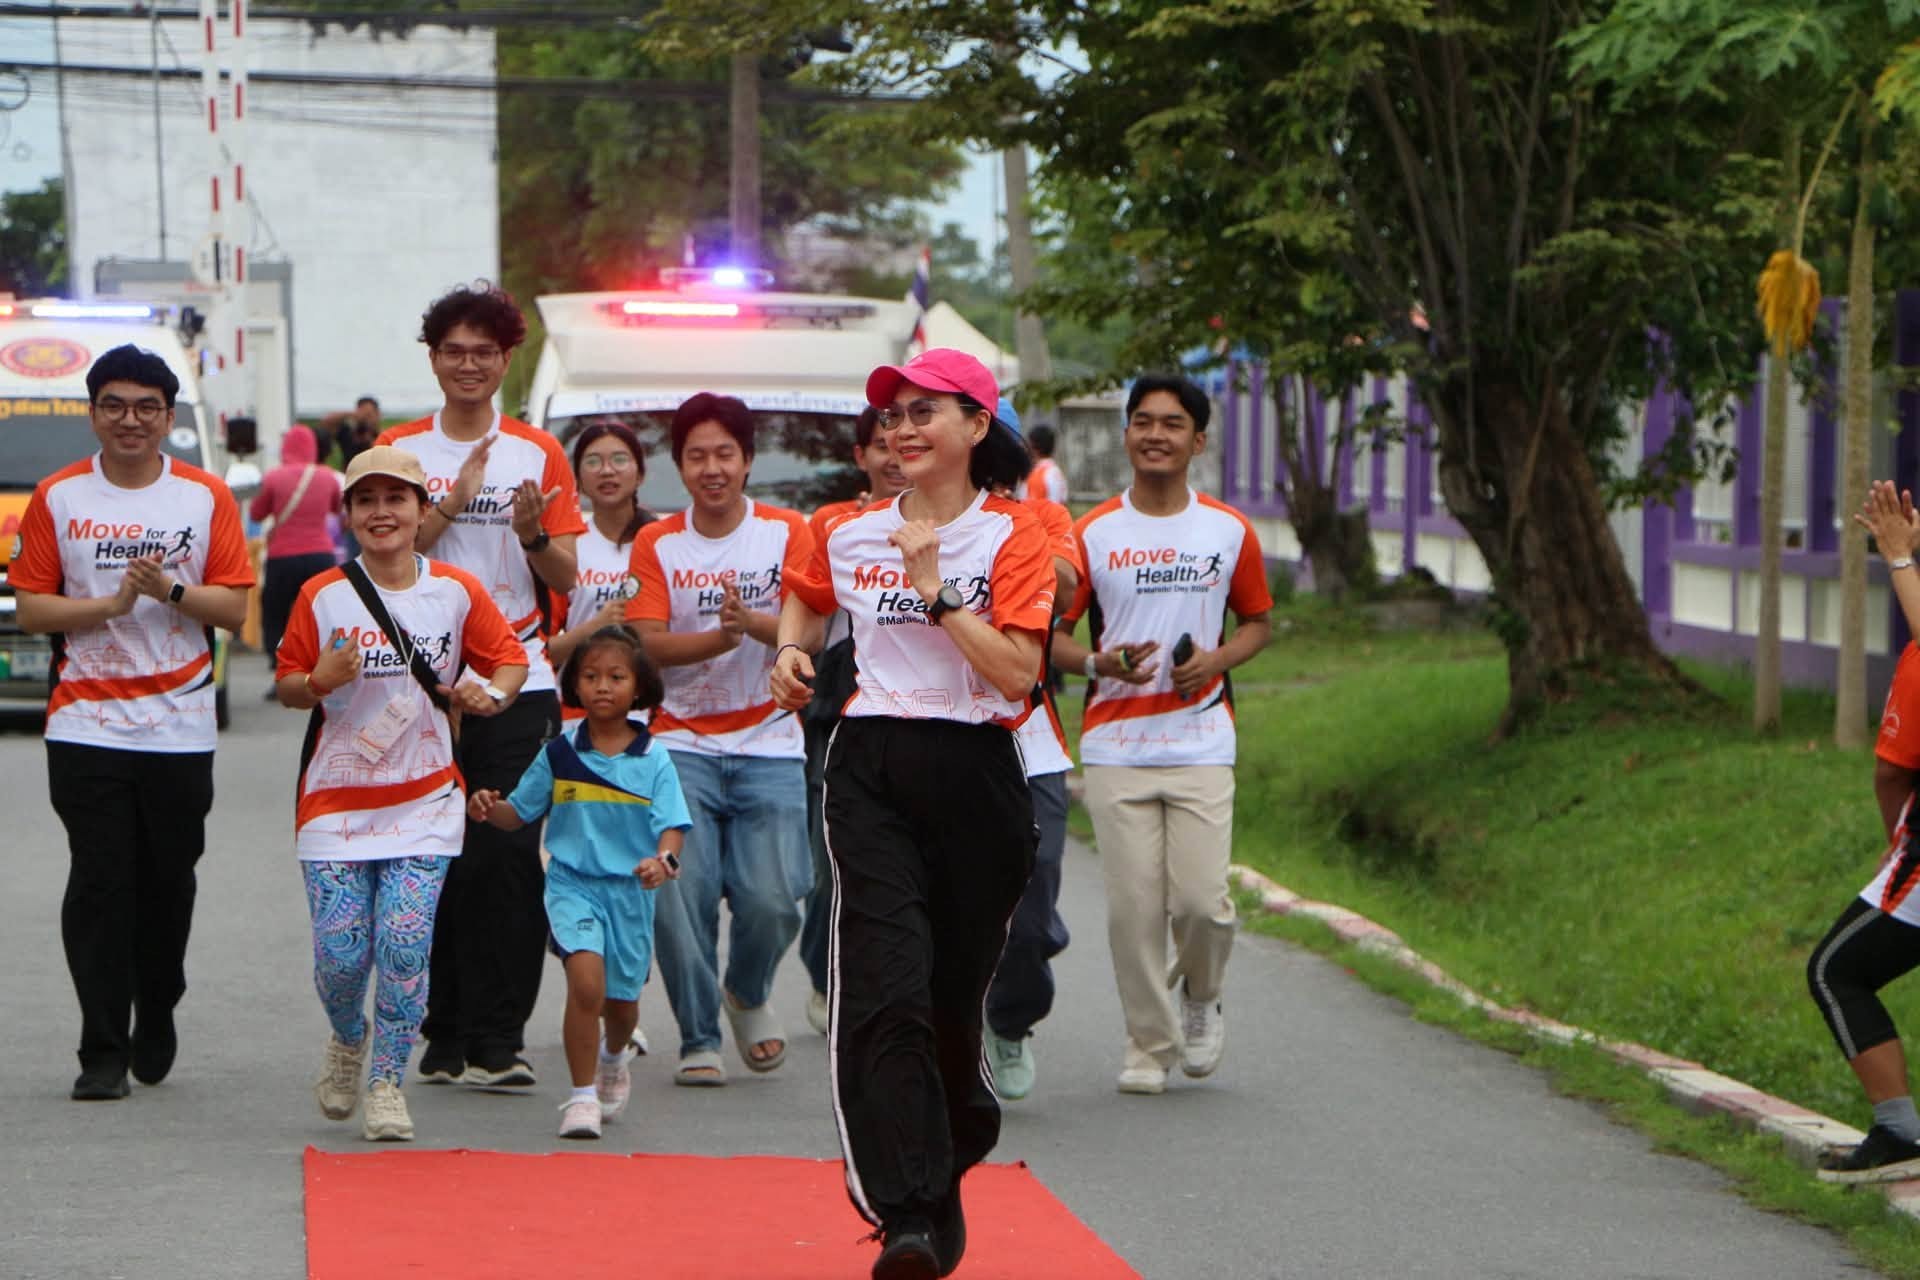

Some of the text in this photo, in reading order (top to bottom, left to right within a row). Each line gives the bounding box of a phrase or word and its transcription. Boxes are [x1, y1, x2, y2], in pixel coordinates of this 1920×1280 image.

[67, 519, 167, 540] Move for
[95, 541, 167, 559] Health
[1108, 547, 1199, 571] Move for
[672, 569, 757, 589] Move for
[852, 565, 912, 590] Mov
[1136, 565, 1199, 585] Health
[698, 584, 760, 607] Heth
[876, 592, 929, 613] Hea
